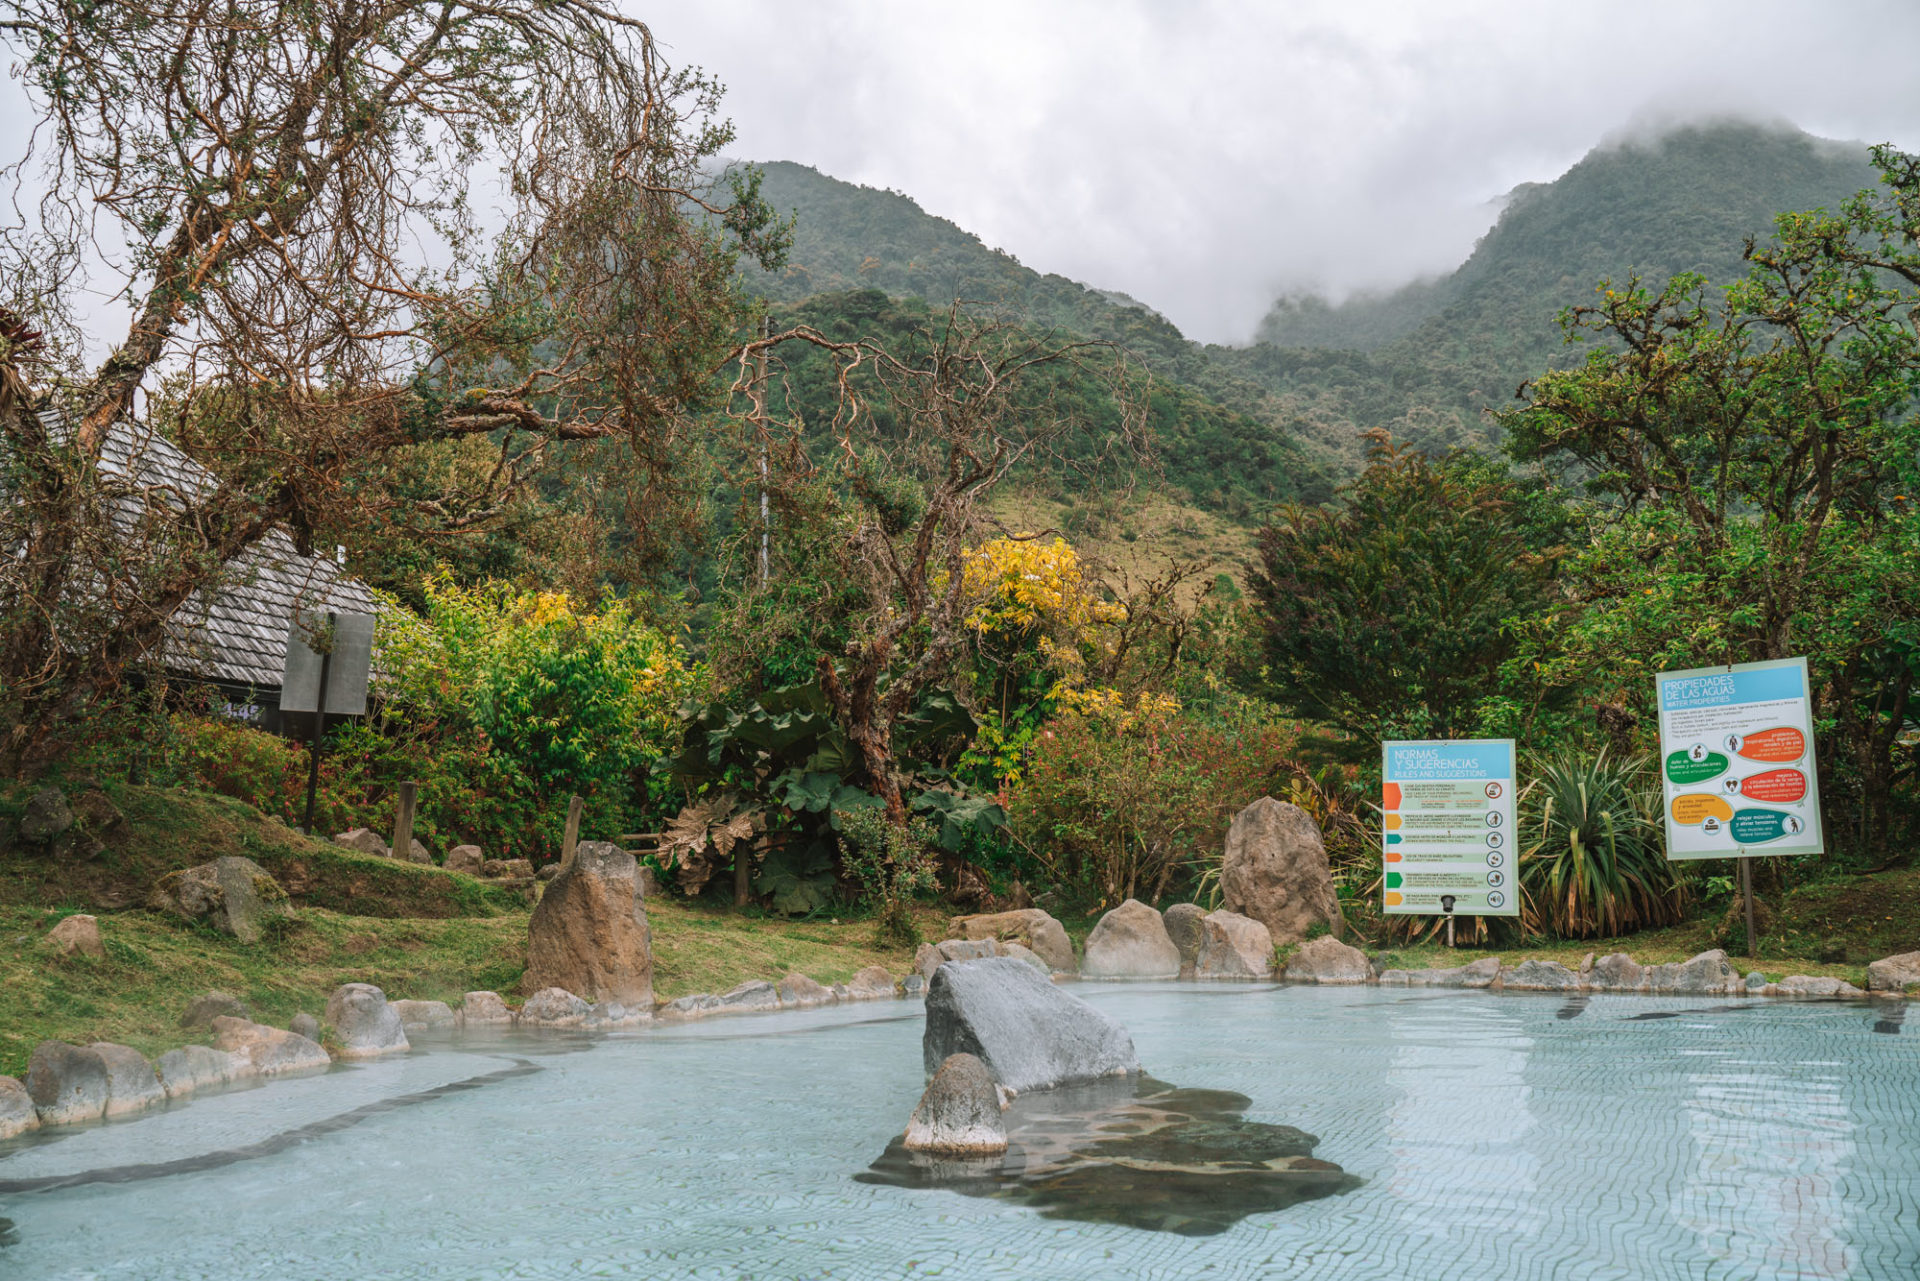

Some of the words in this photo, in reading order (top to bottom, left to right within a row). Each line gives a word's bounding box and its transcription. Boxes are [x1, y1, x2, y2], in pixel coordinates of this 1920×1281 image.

[1665, 676, 1733, 691] PROPIEDADES
[1666, 691, 1680, 700] DE
[1682, 688, 1700, 699] LAS
[1703, 685, 1734, 696] AGUAS
[1689, 696, 1730, 705] PROPERTIES
[1394, 749, 1438, 760] NORMAS
[1395, 760, 1403, 769] Y
[1406, 759, 1479, 769] SUGERENCIAS
